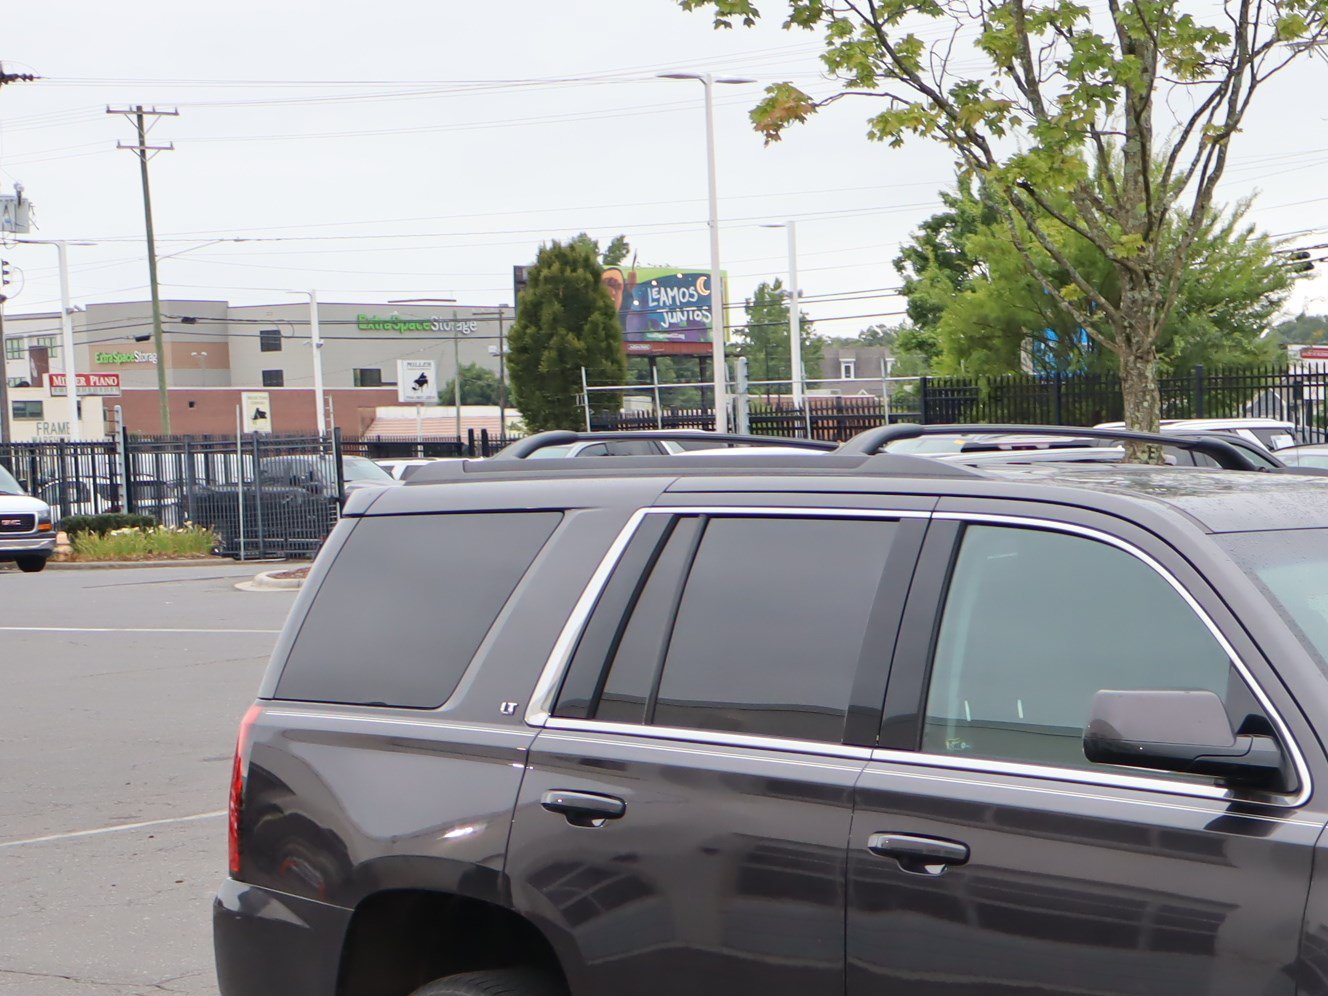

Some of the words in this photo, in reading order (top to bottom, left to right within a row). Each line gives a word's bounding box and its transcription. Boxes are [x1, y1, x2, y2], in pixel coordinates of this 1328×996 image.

[647, 286, 698, 307] LEAMOS
[95, 350, 158, 364] ExtraSpaceStorag
[52, 375, 87, 386] MIER
[89, 375, 118, 386] PIANO
[36, 421, 70, 436] FRAME
[500, 702, 518, 715] LT
